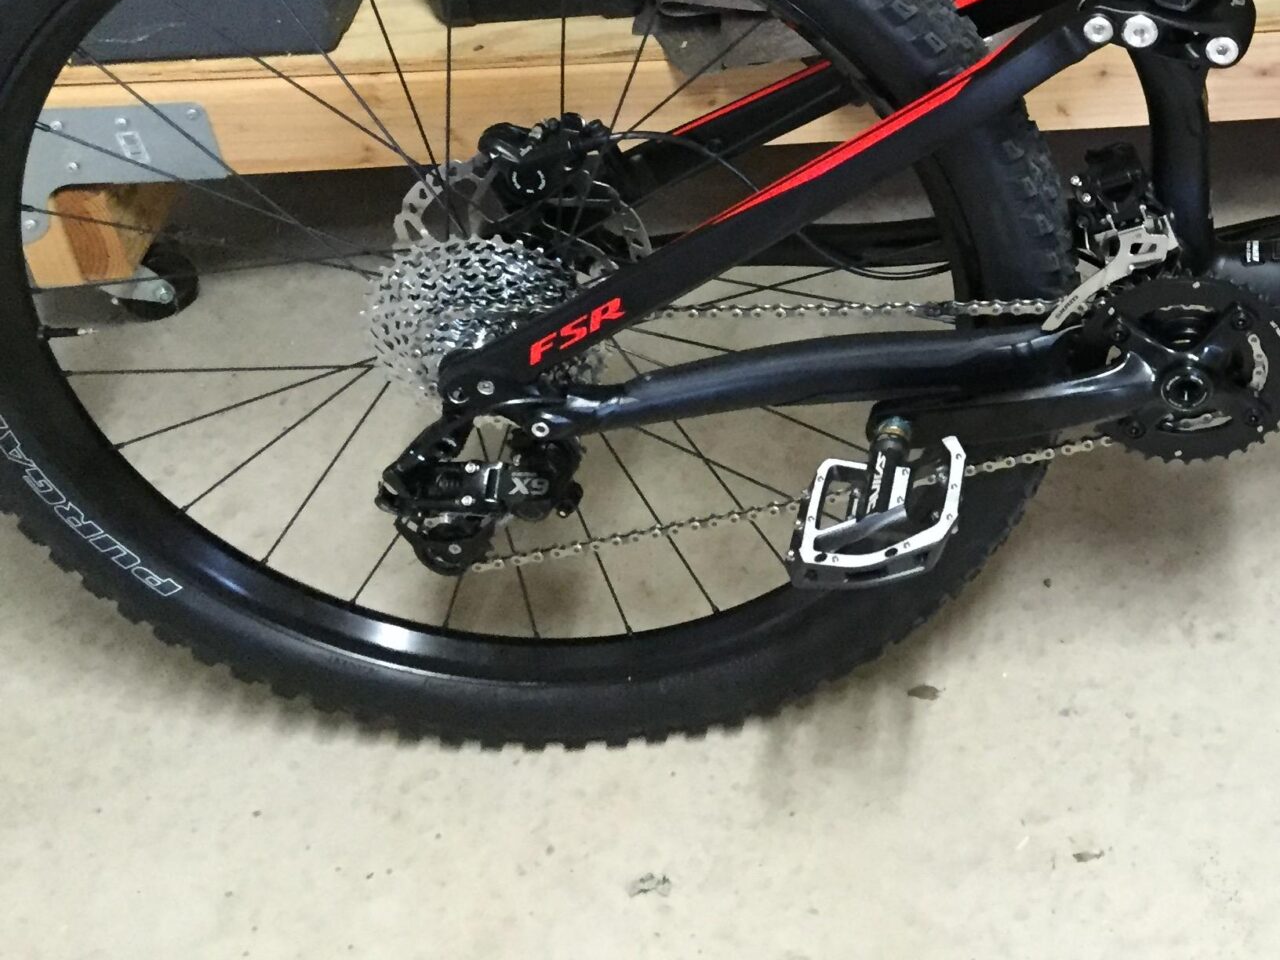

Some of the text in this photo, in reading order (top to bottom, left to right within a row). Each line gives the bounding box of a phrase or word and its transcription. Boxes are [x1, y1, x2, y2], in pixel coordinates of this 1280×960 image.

[529, 297, 626, 366] FSR
[0, 414, 183, 597] PURGA
[507, 476, 550, 496] X9
